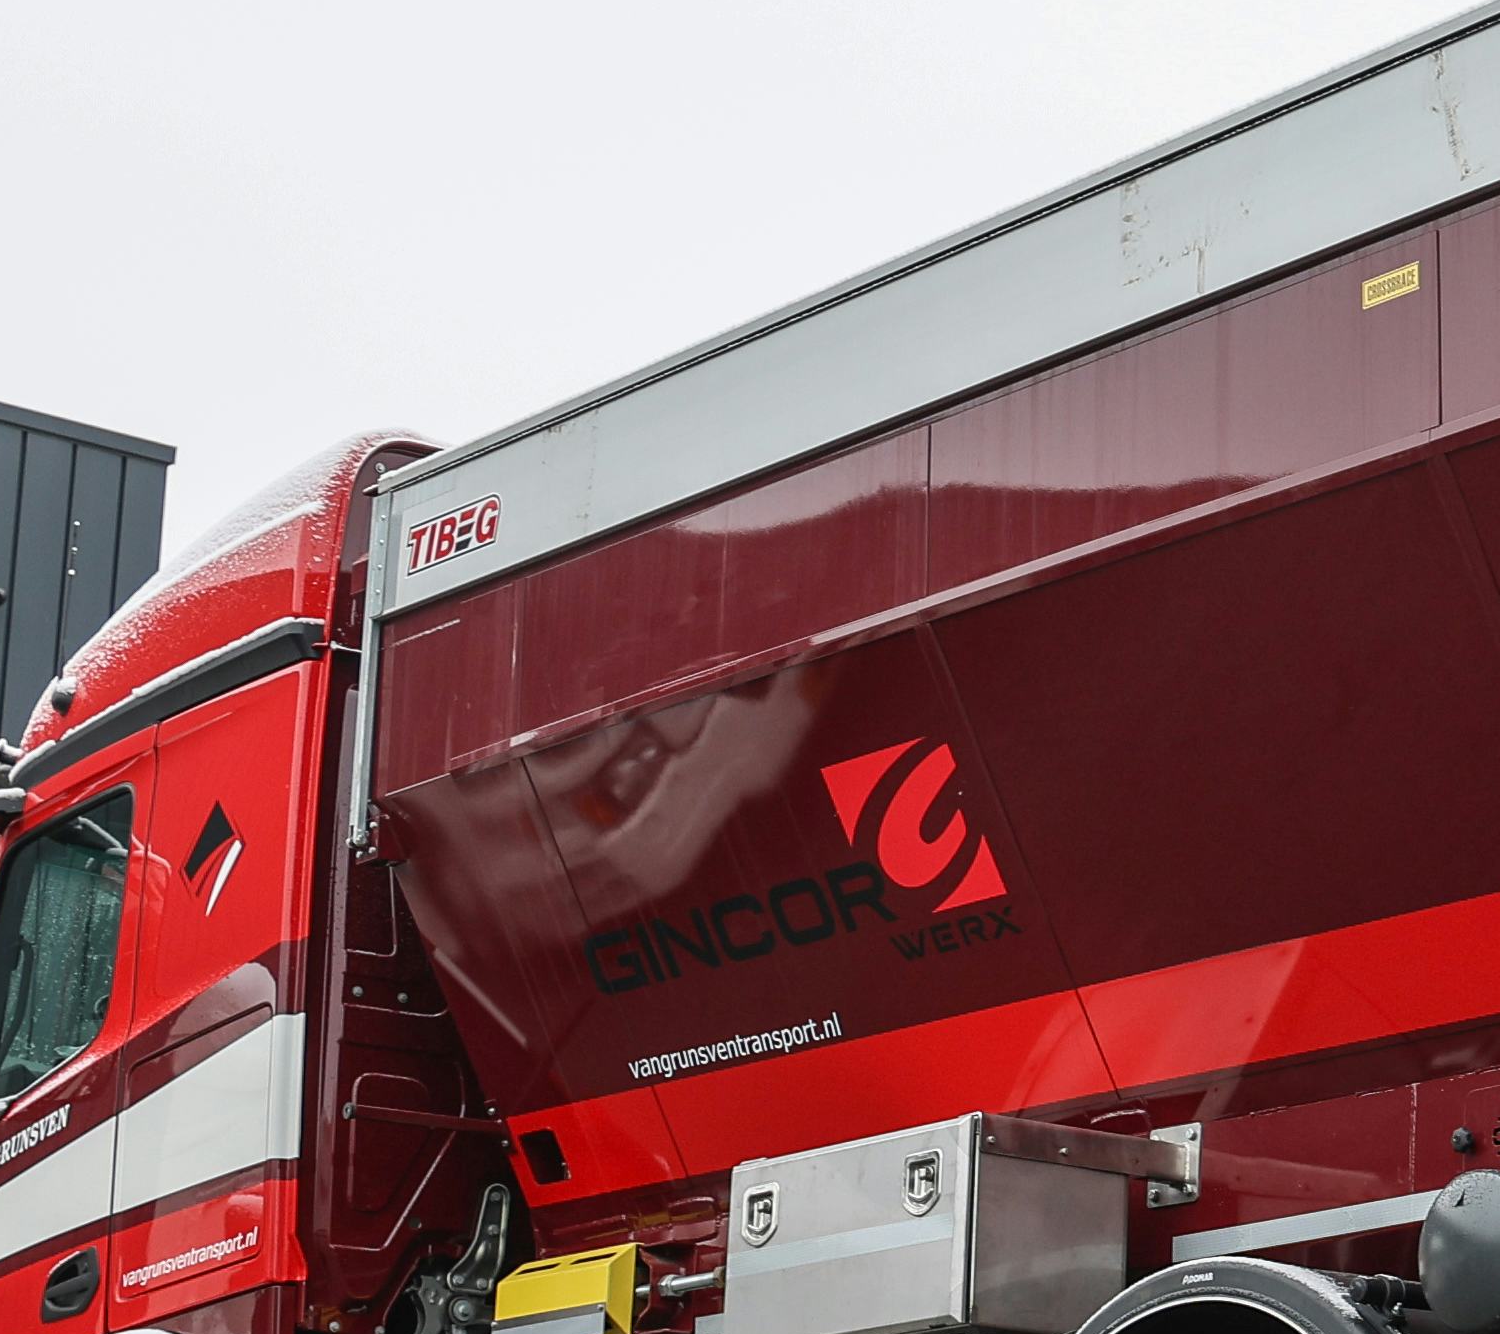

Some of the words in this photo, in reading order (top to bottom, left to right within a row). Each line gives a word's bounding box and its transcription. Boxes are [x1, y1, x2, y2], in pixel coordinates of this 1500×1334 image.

[1367, 268, 1416, 301] CROSSBRACE
[410, 499, 499, 570] TIBEG
[583, 860, 898, 996] GINCOR
[889, 905, 1025, 962] WERX
[627, 1011, 842, 1080] vangrunsventransport.nl
[121, 1226, 259, 1289] vangrunsventransport.nl
